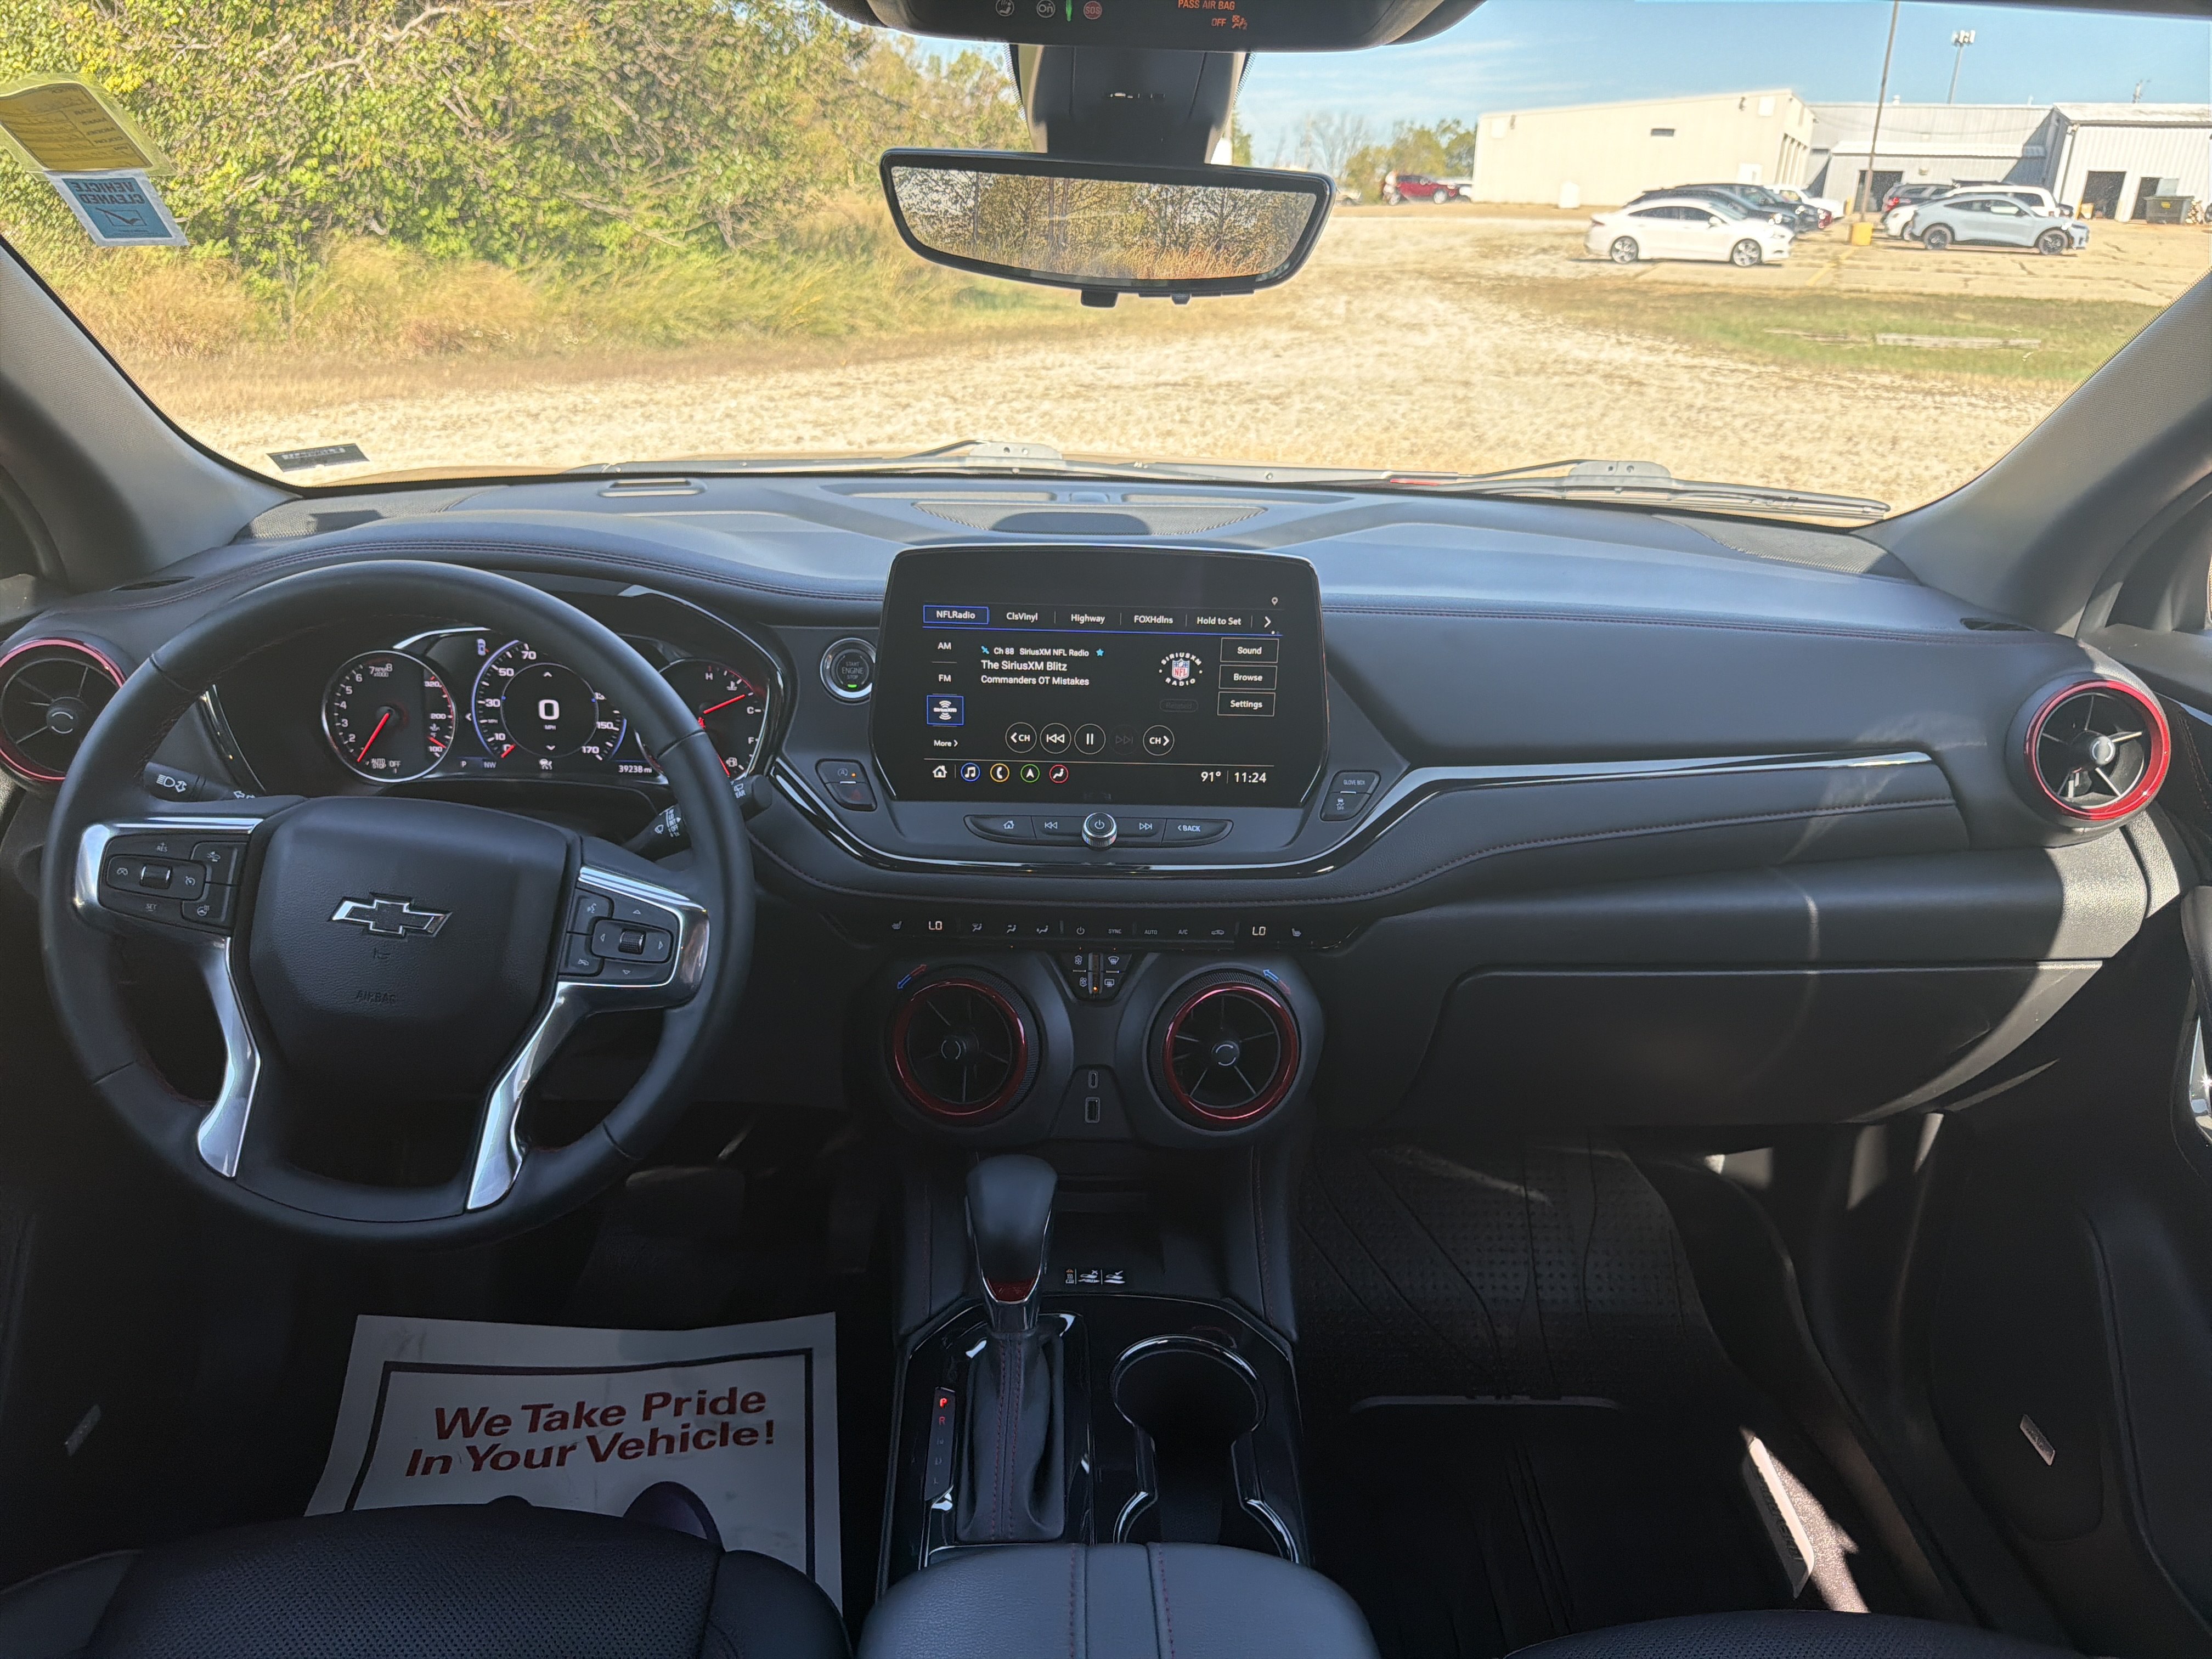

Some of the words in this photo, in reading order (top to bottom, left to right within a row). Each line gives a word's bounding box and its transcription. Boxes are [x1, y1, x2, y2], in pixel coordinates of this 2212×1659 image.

[1178, 0, 1200, 8] PASS
[1202, 1, 1216, 9] AIR
[1218, 1, 1235, 10] BAG
[1085, 6, 1101, 15] SOS
[1211, 18, 1226, 27] OFF
[936, 611, 975, 619] NFLRadio
[1006, 613, 1038, 623] ClsVinyl
[1071, 614, 1105, 624] Highway
[1197, 617, 1216, 625] Hold
[1237, 646, 1262, 654] Sound
[522, 651, 537, 659] 70
[1161, 652, 1201, 665] SIRIUSXM
[369, 665, 375, 675] 7
[386, 663, 393, 672] 8
[981, 660, 999, 669] The
[1001, 661, 1043, 670] SiriusXM
[1046, 662, 1068, 671] Blitz
[1175, 668, 1187, 676] NFL
[356, 673, 363, 682] 6
[981, 675, 1036, 685] Commanders
[1039, 676, 1050, 685] OT
[1052, 678, 1090, 686] Mistakes
[1165, 677, 1195, 686] RADIO
[1233, 673, 1262, 681] Browse
[345, 686, 353, 695] 5
[340, 701, 347, 709] 4
[485, 699, 500, 707] 30
[1230, 699, 1262, 710] Settings
[538, 699, 559, 720] 0
[341, 719, 348, 727] 3
[349, 733, 356, 742] 2
[1201, 771, 1221, 782] 91°
[1234, 771, 1267, 783] 11:24
[1182, 825, 1201, 833] BACK
[928, 921, 943, 930] LO
[1252, 926, 1266, 936] LO
[939, 1397, 948, 1408] P
[435, 1407, 512, 1440] We
[521, 1400, 627, 1434] Take
[641, 1386, 767, 1423] Pride
[939, 1416, 945, 1425] R
[405, 1448, 451, 1477] In
[465, 1441, 578, 1472] Your
[585, 1419, 775, 1464] Vehicle!
